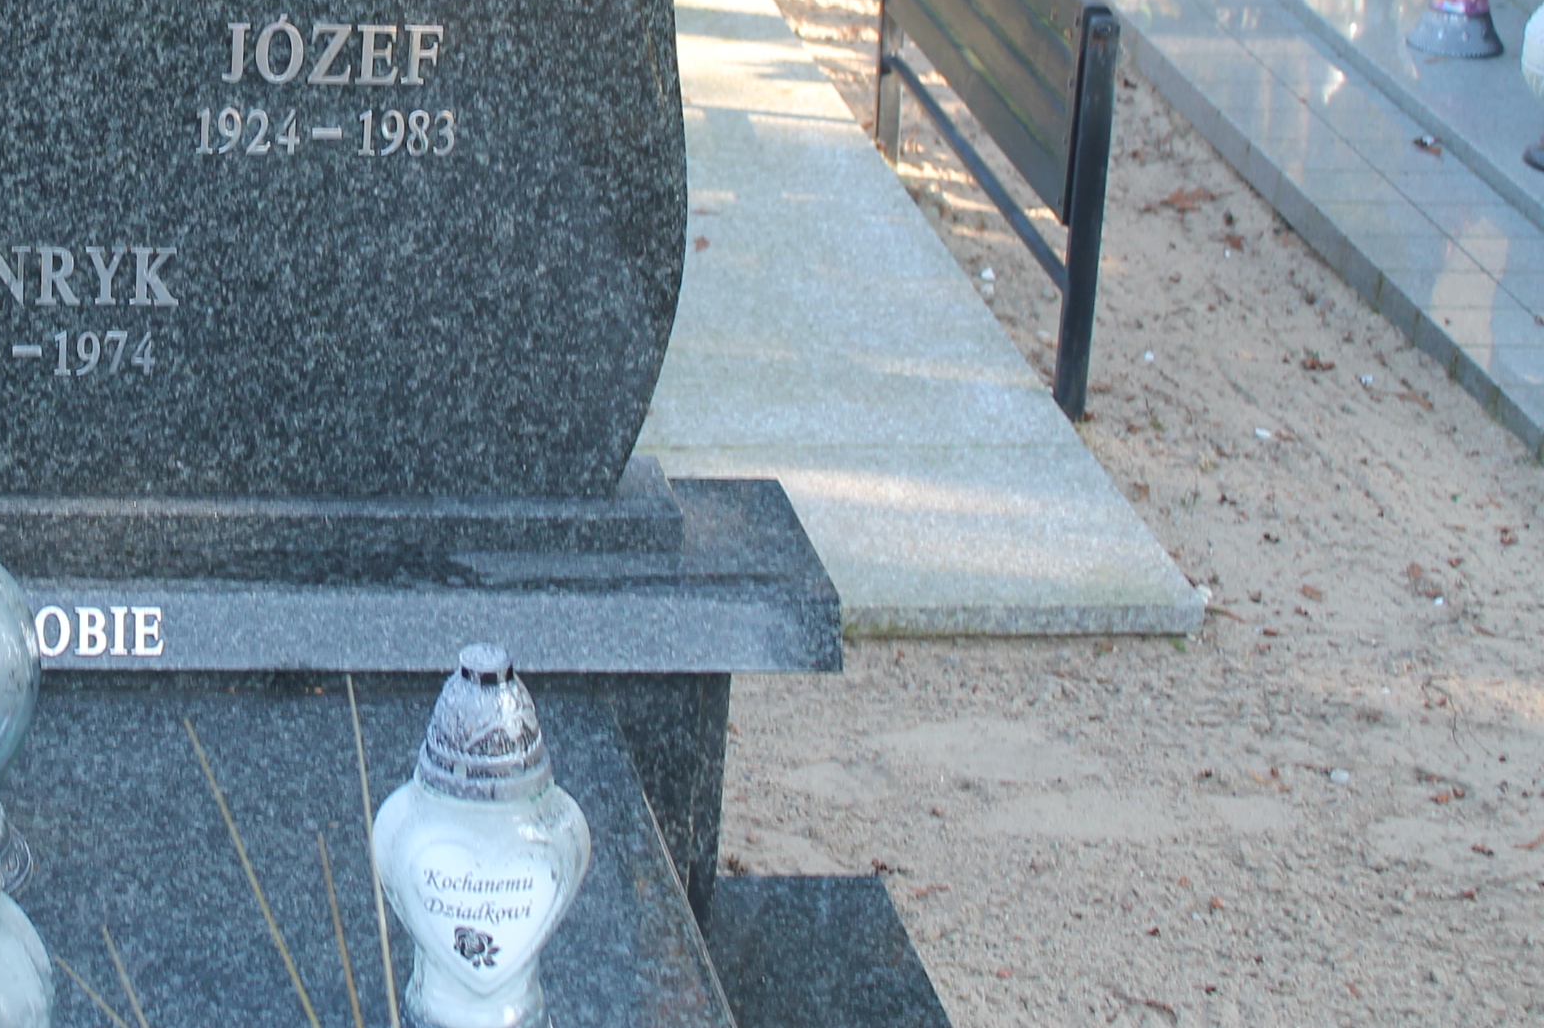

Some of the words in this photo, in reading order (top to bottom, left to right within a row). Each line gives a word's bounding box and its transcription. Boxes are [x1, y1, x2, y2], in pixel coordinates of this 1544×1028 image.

[221, 13, 445, 87] JÓZEF
[34, 605, 165, 657] OBIE
[424, 868, 535, 894] Kochanemu
[423, 896, 533, 926] Dziadkowi
